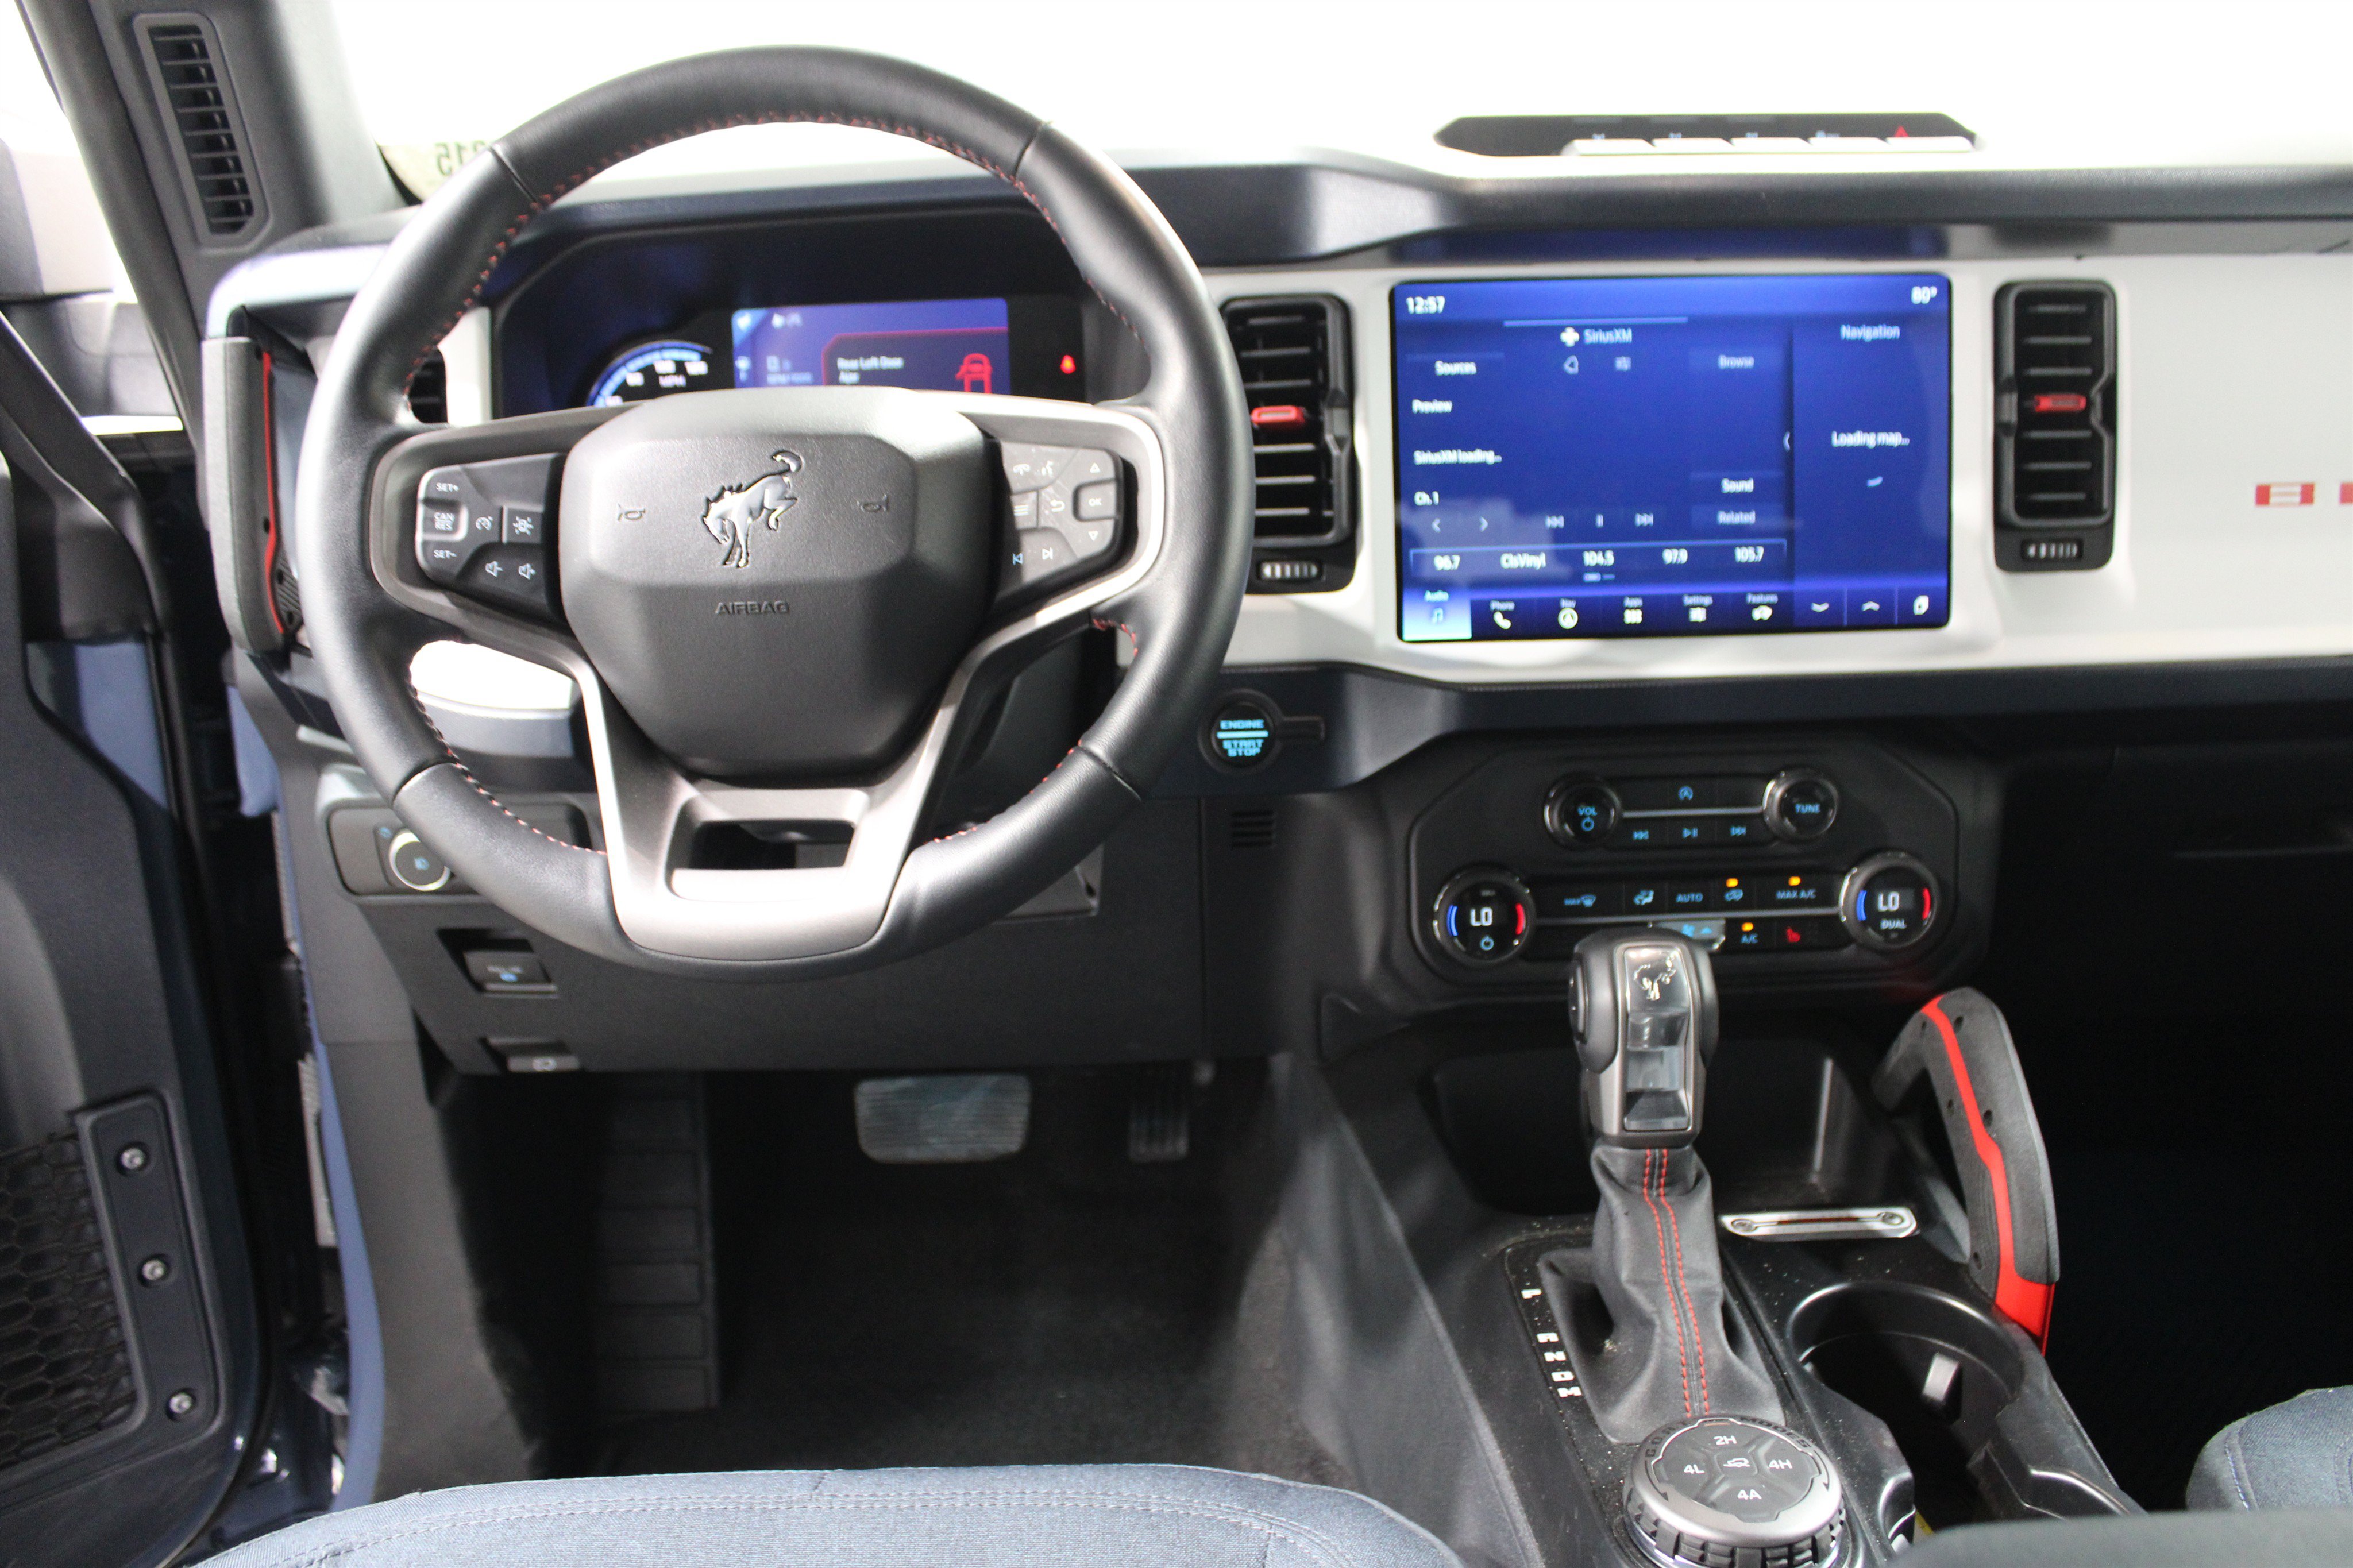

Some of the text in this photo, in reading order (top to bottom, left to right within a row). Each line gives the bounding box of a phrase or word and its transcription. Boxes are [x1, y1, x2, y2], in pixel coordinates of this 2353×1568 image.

[1406, 296, 1445, 314] 12:57
[1584, 328, 1633, 345] SiriusXM
[1841, 324, 1900, 341] Navigation
[1718, 354, 1754, 369] Browse
[1436, 360, 1476, 376] Sources
[1412, 399, 1452, 414] Preview
[1831, 430, 1876, 449] Loading
[1414, 450, 1457, 465] SiriusXM
[436, 482, 459, 492] SET+
[1721, 478, 1754, 493] Sound
[1089, 498, 1102, 507] OK
[434, 512, 454, 522] CAN
[1717, 511, 1756, 525] Related
[435, 520, 453, 531] RES
[1662, 549, 1688, 565] 97.9
[1734, 546, 1764, 562] 105.7
[1424, 590, 1449, 602] Audio
[1683, 594, 1713, 607] Settings
[715, 601, 790, 616] AIRBAG
[1220, 719, 1264, 730] ENGINE
[1222, 738, 1264, 749] START
[1228, 747, 1261, 757] STOP
[1577, 806, 1598, 817] VOL
[1795, 803, 1821, 814] TUNE
[1676, 893, 1703, 903] AUTO
[1776, 889, 1816, 899] MAX A/C
[1877, 891, 1900, 912] LO
[1469, 906, 1493, 926] LO
[1880, 919, 1907, 930] DUAL
[1741, 933, 1758, 944] A/C
[1544, 1351, 1567, 1362] N
[1713, 1435, 1737, 1445] 2H
[1683, 1463, 1704, 1474] 4L
[1768, 1459, 1793, 1470] 4H
[1737, 1489, 1762, 1500] 4A
